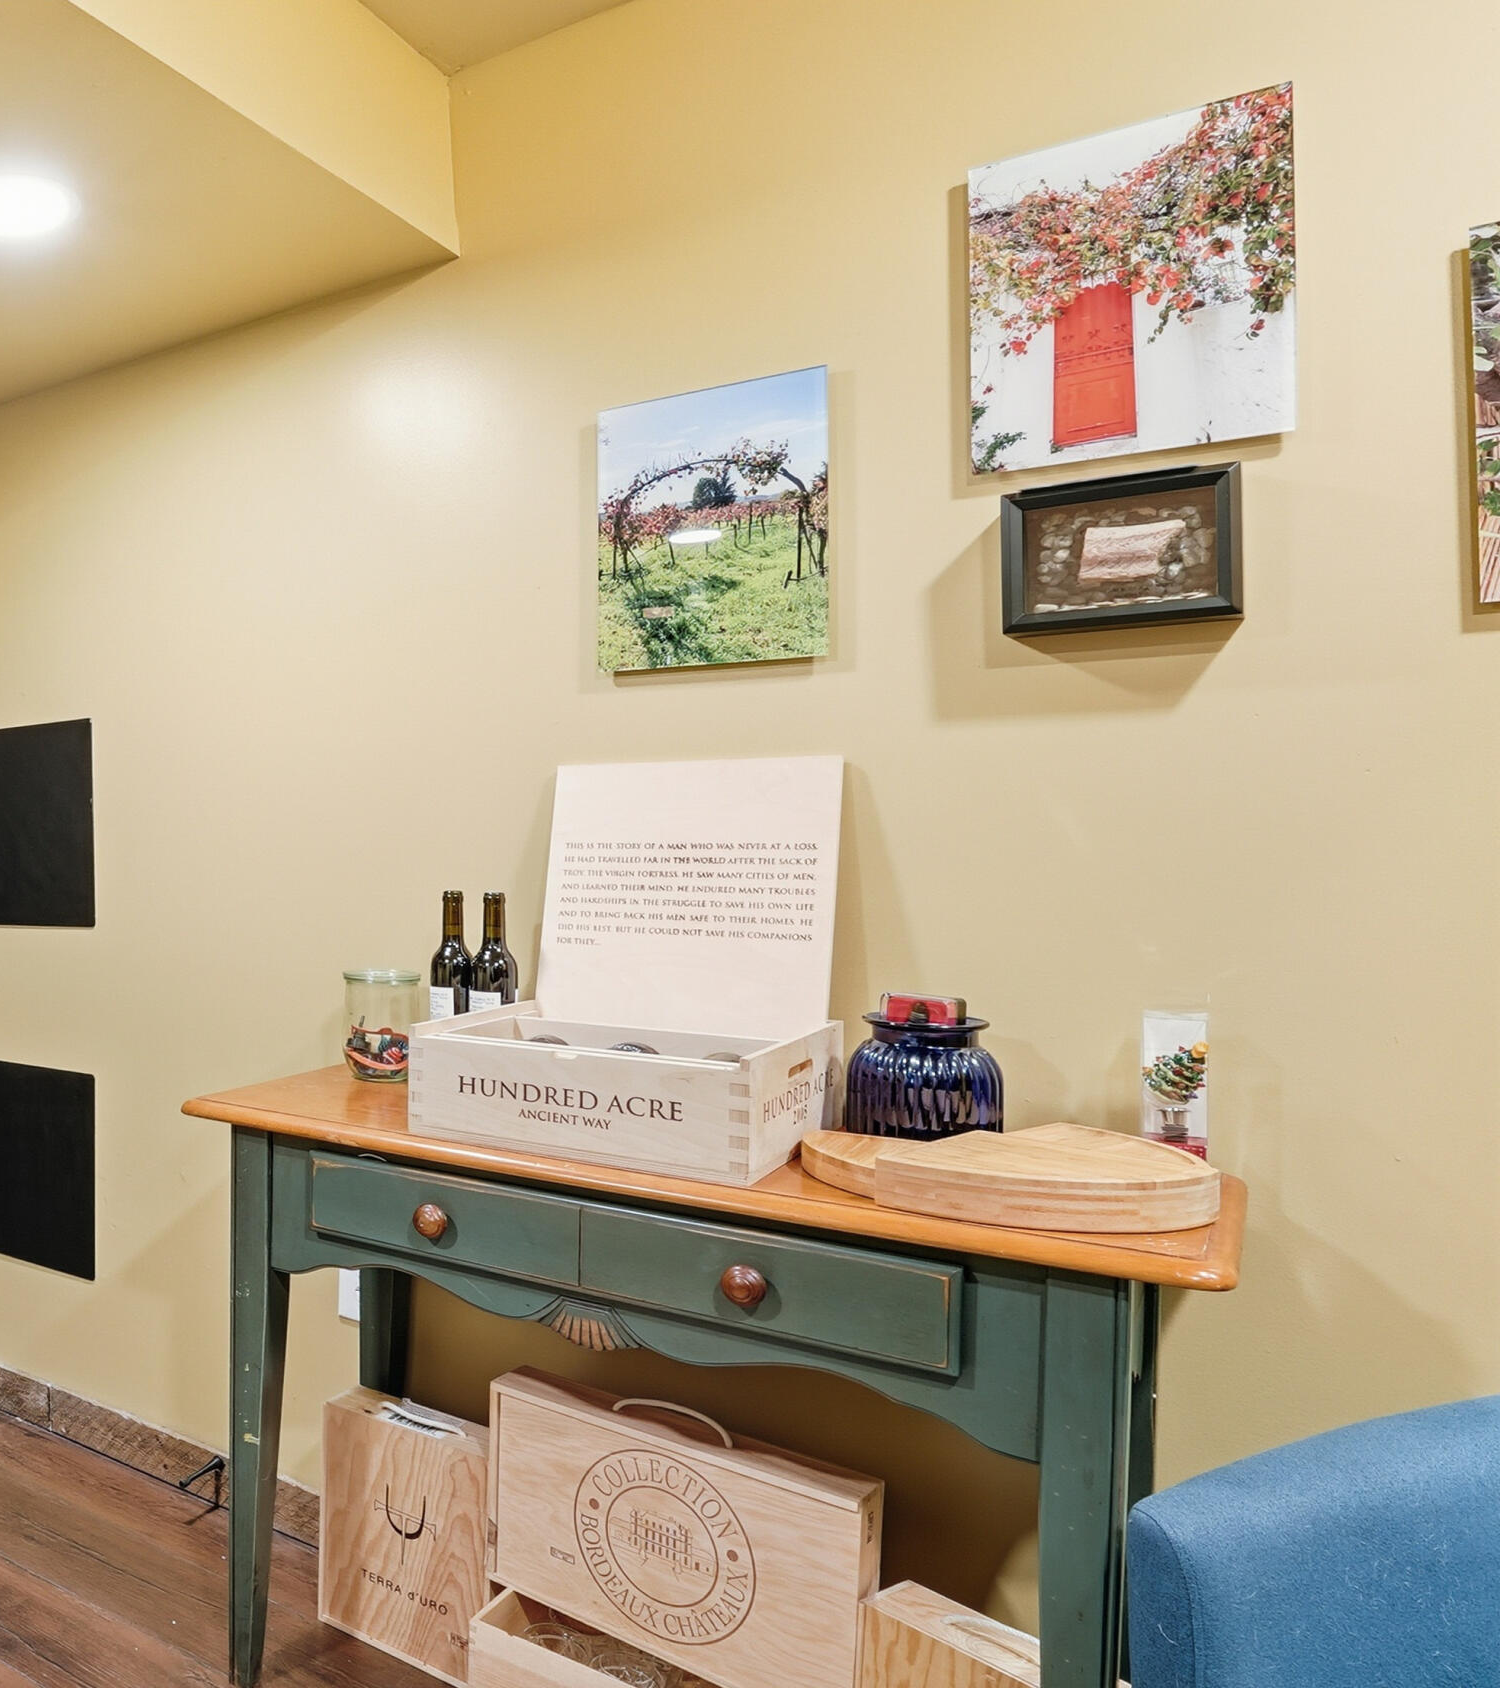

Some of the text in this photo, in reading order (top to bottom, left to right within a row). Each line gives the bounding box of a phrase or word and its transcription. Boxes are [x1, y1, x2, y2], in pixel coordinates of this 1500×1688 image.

[598, 842, 613, 850] THE
[616, 842, 641, 850] STORY
[644, 842, 655, 850] OF
[727, 857, 755, 865] AFTER
[758, 857, 775, 865] THE
[588, 869, 603, 877] THE
[745, 872, 775, 880] CITIES
[777, 872, 789, 880] OF
[768, 887, 816, 896] TROUBLES
[642, 898, 659, 906] THE
[662, 899, 706, 908] STRUGGLE
[709, 900, 722, 908] TO
[725, 901, 745, 909] SAVE
[748, 902, 764, 910] HIS
[767, 902, 792, 910] OWN
[795, 903, 814, 911] LIFE
[666, 913, 686, 921] MEN
[713, 915, 725, 923] TO
[729, 916, 757, 924] THEIR
[800, 918, 813, 926] HE
[558, 923, 573, 931] DID
[634, 926, 646, 934] HE
[648, 927, 680, 935] COULD
[682, 928, 703, 937] NOT
[705, 929, 725, 938] SAVE
[728, 930, 745, 938] HIS
[458, 1075, 684, 1122] HUNDRED ACRE
[764, 1081, 811, 1123] HUNDRED
[517, 1108, 612, 1131] ANCIENT WAY
[592, 1457, 739, 1539] COLLECTION
[580, 1513, 749, 1637] BORDEAUX CHÂTEAUX
[360, 1567, 448, 1616] TERRA d'URO
